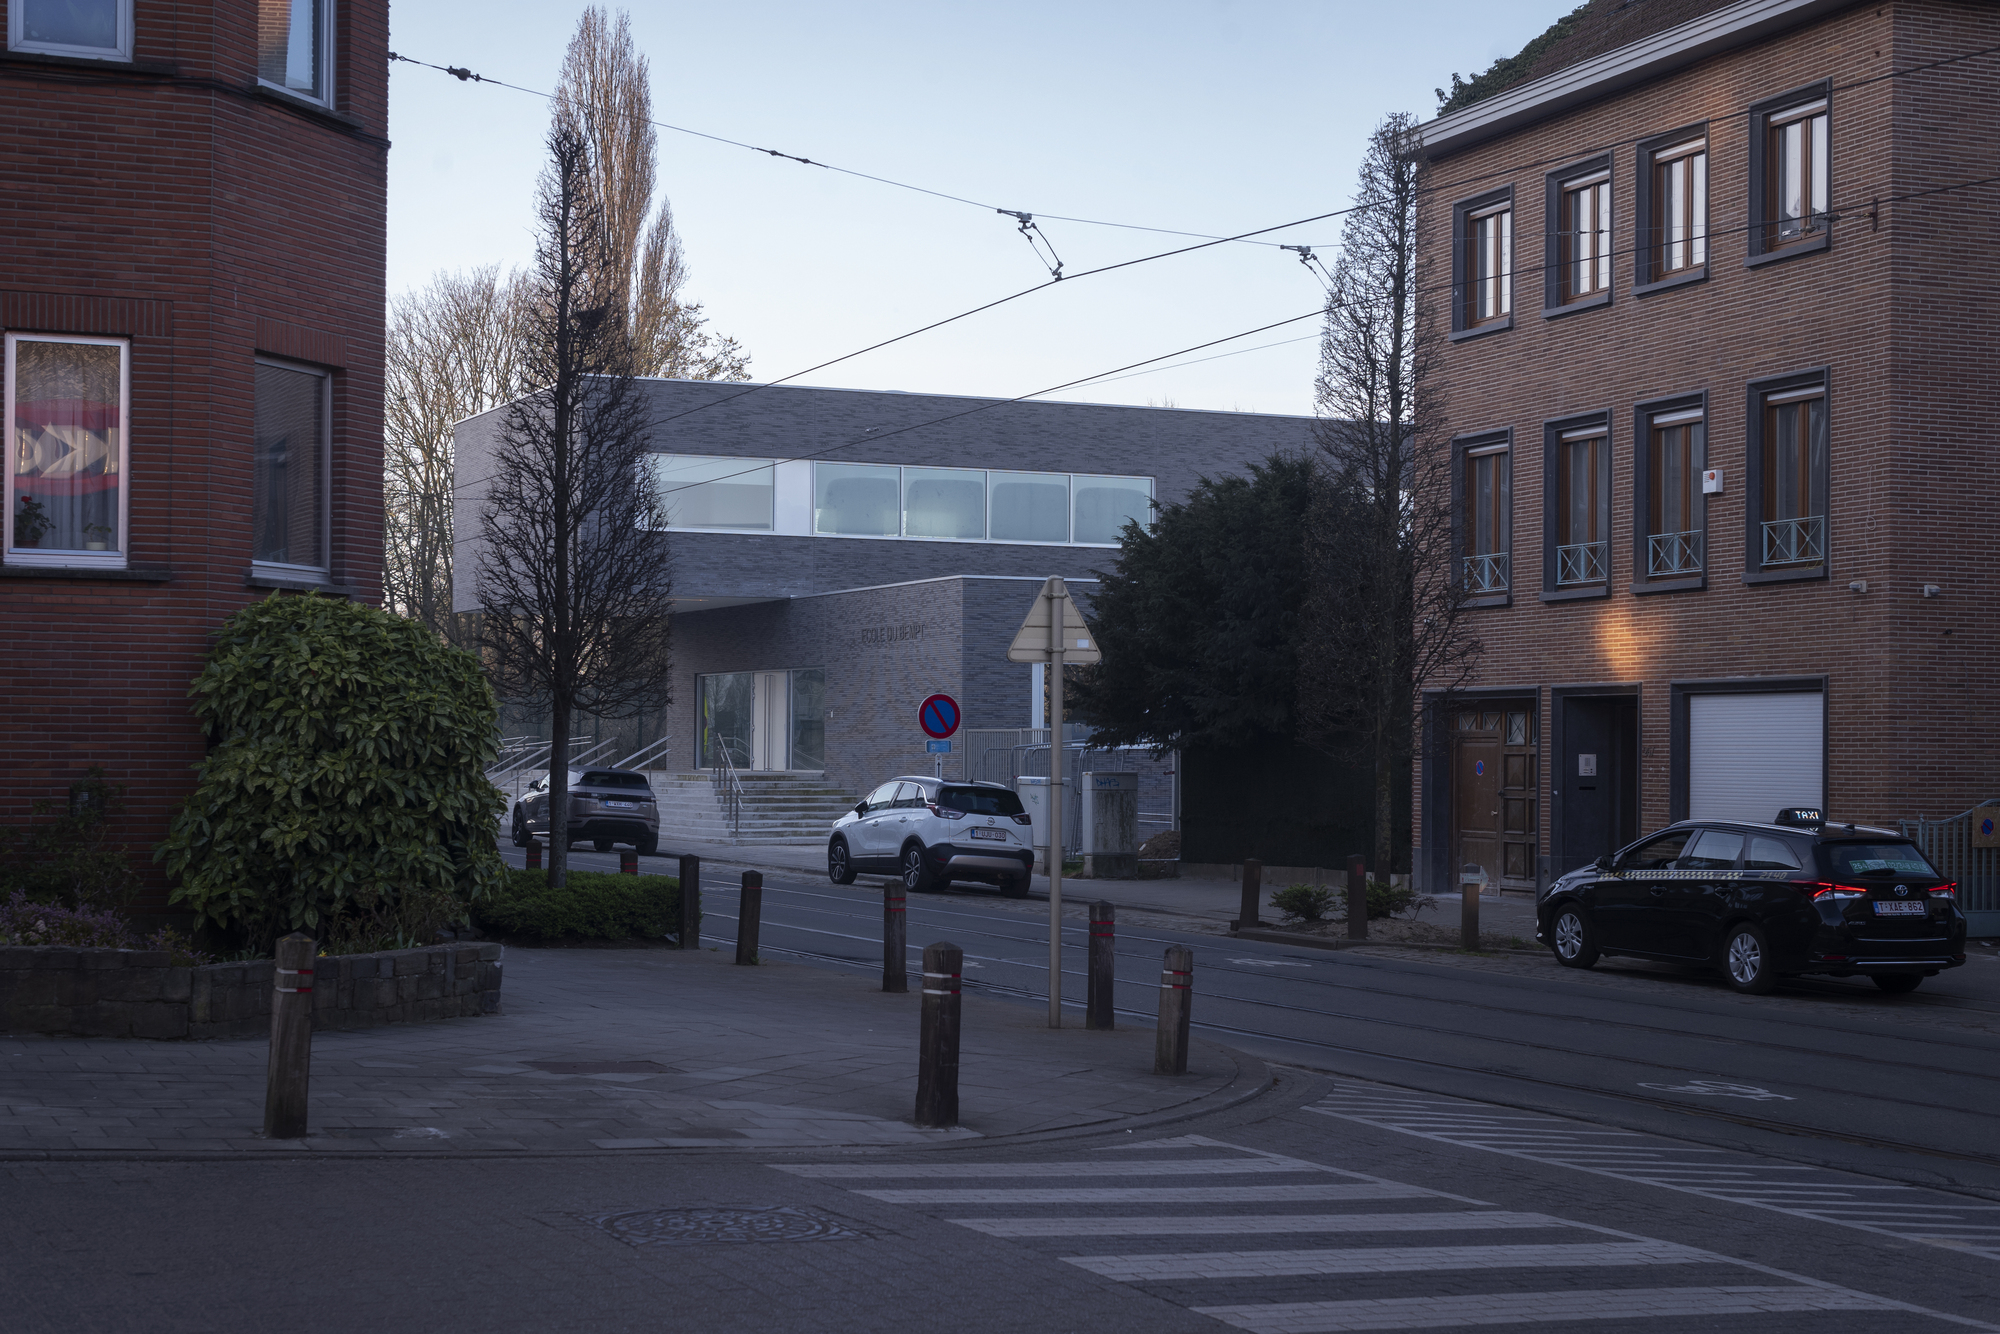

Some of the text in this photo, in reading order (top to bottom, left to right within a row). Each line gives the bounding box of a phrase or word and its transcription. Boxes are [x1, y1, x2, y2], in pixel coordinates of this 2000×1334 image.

[861, 627, 886, 644] ECOLE
[887, 625, 898, 642] DU
[1794, 810, 1820, 820] TAXI
[1758, 871, 1788, 880] 2140
